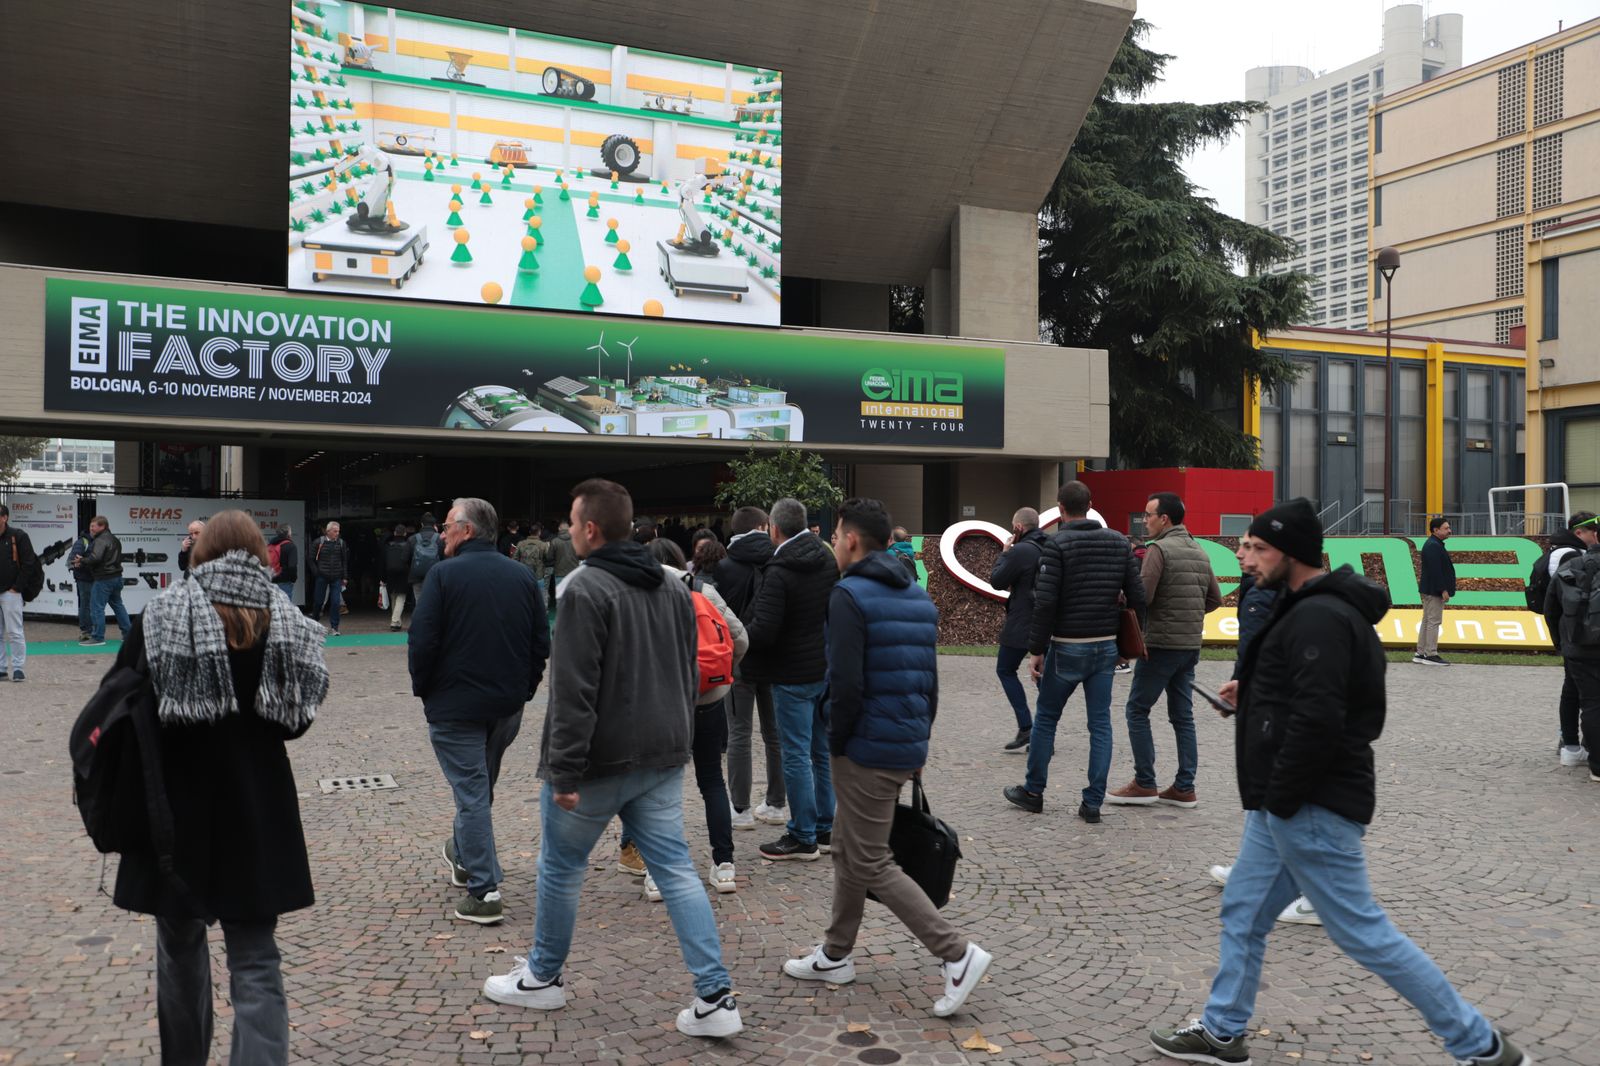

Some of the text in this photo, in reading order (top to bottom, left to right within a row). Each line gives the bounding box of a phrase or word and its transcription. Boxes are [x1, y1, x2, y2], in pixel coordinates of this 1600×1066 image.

[78, 305, 101, 366] EIMA
[117, 300, 392, 343] THE INNOVATION
[117, 331, 392, 385] FACTORY
[70, 376, 372, 405] BOLOGNA, 6-10 NOVEMBRE / NOVEMBER 2024
[865, 403, 961, 418] international
[860, 419, 912, 430] TWENTY
[933, 422, 965, 432] FOUR
[129, 507, 183, 520] ERHAS
